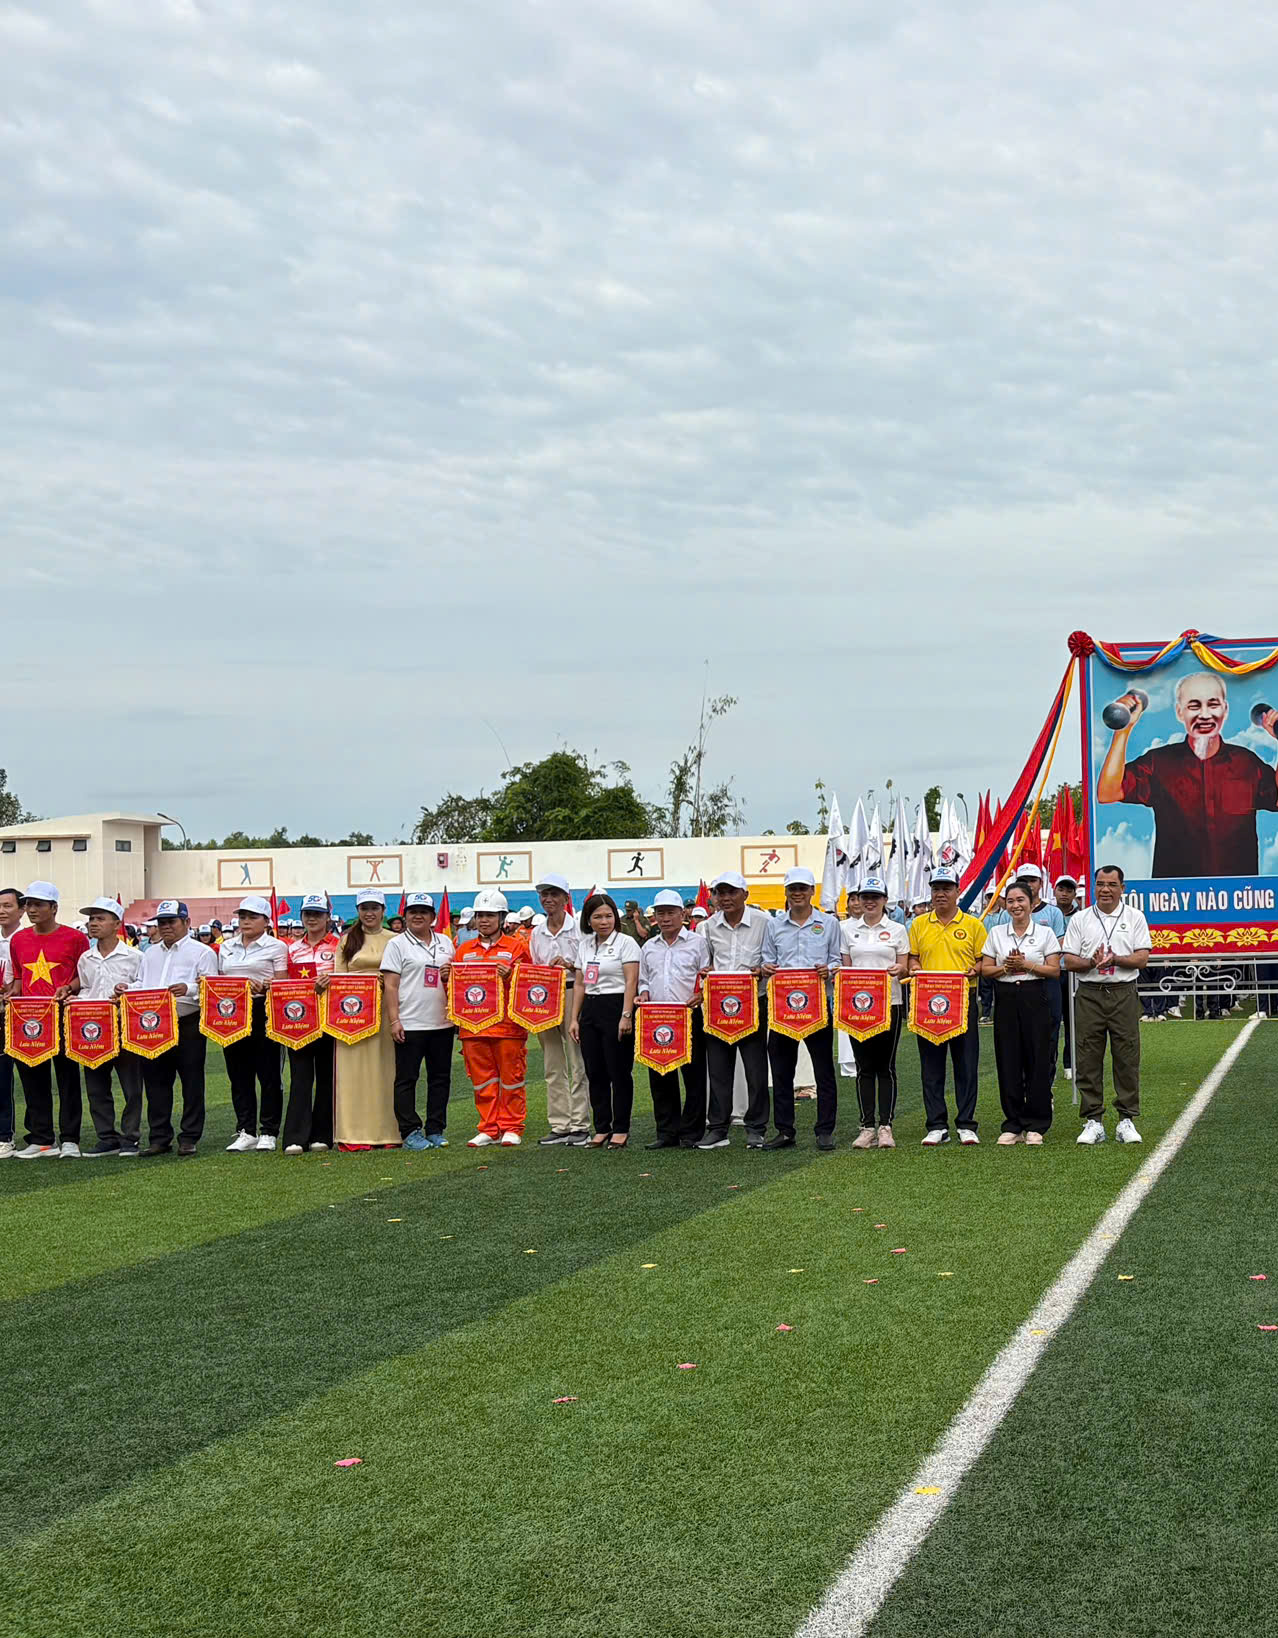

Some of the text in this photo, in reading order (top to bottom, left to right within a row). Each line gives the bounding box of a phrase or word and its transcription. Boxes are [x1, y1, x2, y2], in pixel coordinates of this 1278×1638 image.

[1121, 889, 1144, 911] TÔI
[1149, 888, 1190, 912] NGÀY
[1196, 887, 1228, 911] NÀO
[1233, 885, 1275, 910] CŨNG
